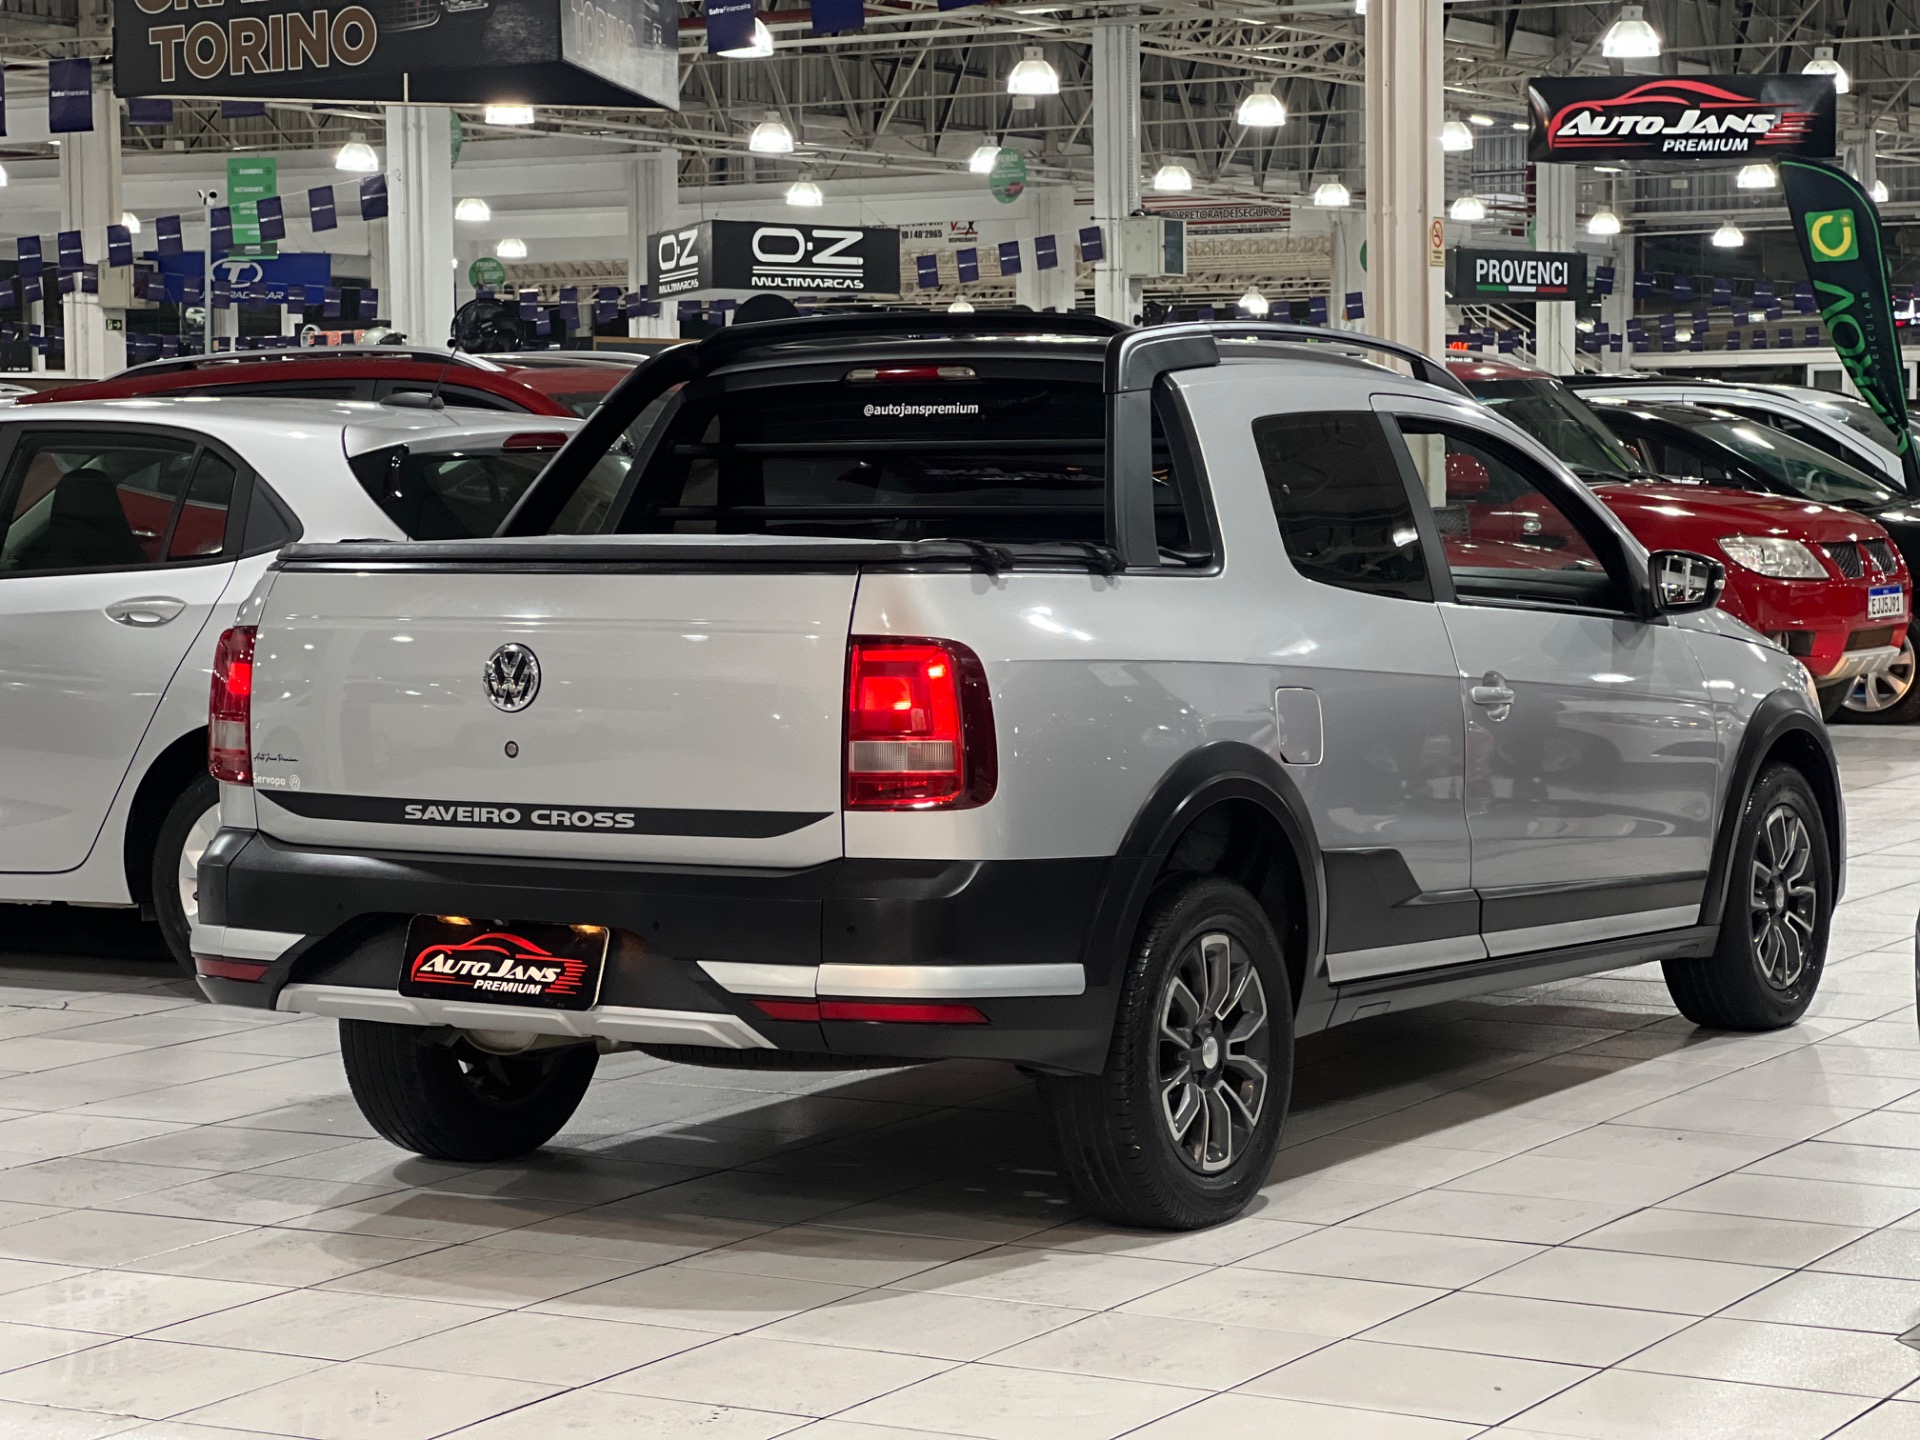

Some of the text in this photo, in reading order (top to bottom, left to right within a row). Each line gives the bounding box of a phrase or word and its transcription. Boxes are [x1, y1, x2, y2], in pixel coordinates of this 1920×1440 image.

[149, 6, 377, 82] TORINO
[1662, 138, 1749, 152] PREMIUM
[1167, 208, 1219, 221] ORRETORA
[1238, 206, 1283, 218] SEGUROS
[1476, 258, 1568, 285] PROVENCI
[658, 278, 699, 295] MULTIMARCAS
[751, 276, 864, 289] MULTIMARCAS
[863, 402, 979, 417] @autojanspremium
[252, 772, 286, 788] Servopa
[405, 804, 635, 829] SAVEIRO CROSS
[473, 979, 543, 995] PREMIUM
